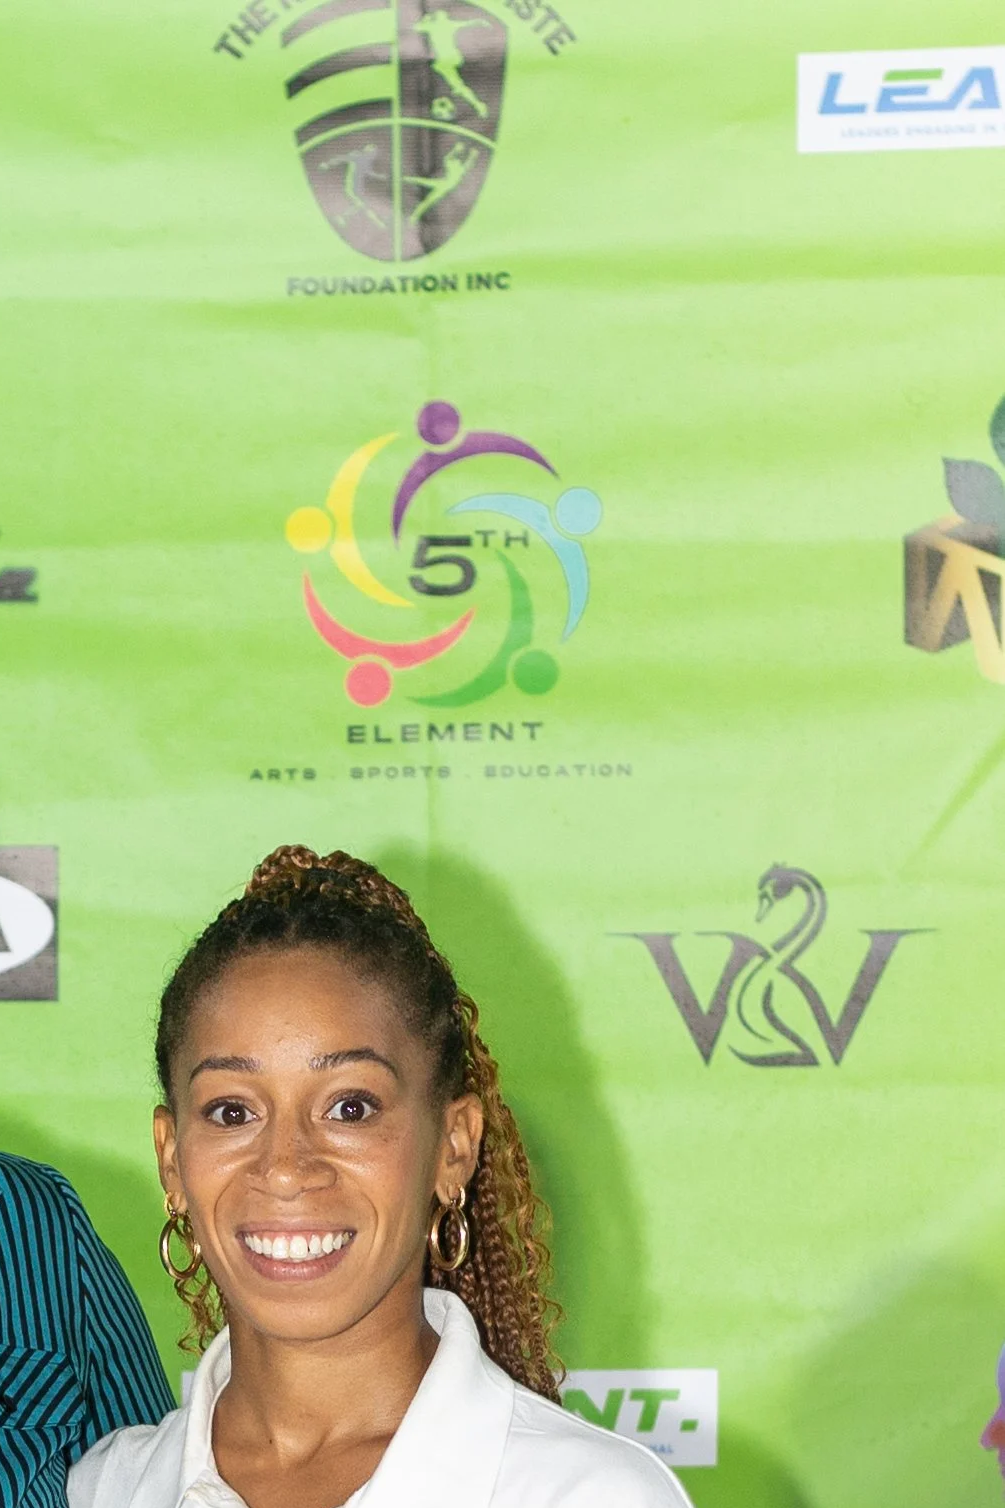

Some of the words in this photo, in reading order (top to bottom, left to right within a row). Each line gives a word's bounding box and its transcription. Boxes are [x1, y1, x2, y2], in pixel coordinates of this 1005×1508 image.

[213, 0, 280, 58] THE
[287, 273, 459, 297] FOUNDATION
[466, 271, 512, 292] INC
[407, 529, 530, 597] 5TH
[346, 721, 545, 745] ELEMENT
[249, 767, 318, 781] ARTS
[349, 765, 452, 780] SPORTS
[483, 763, 634, 779] EDUCATION
